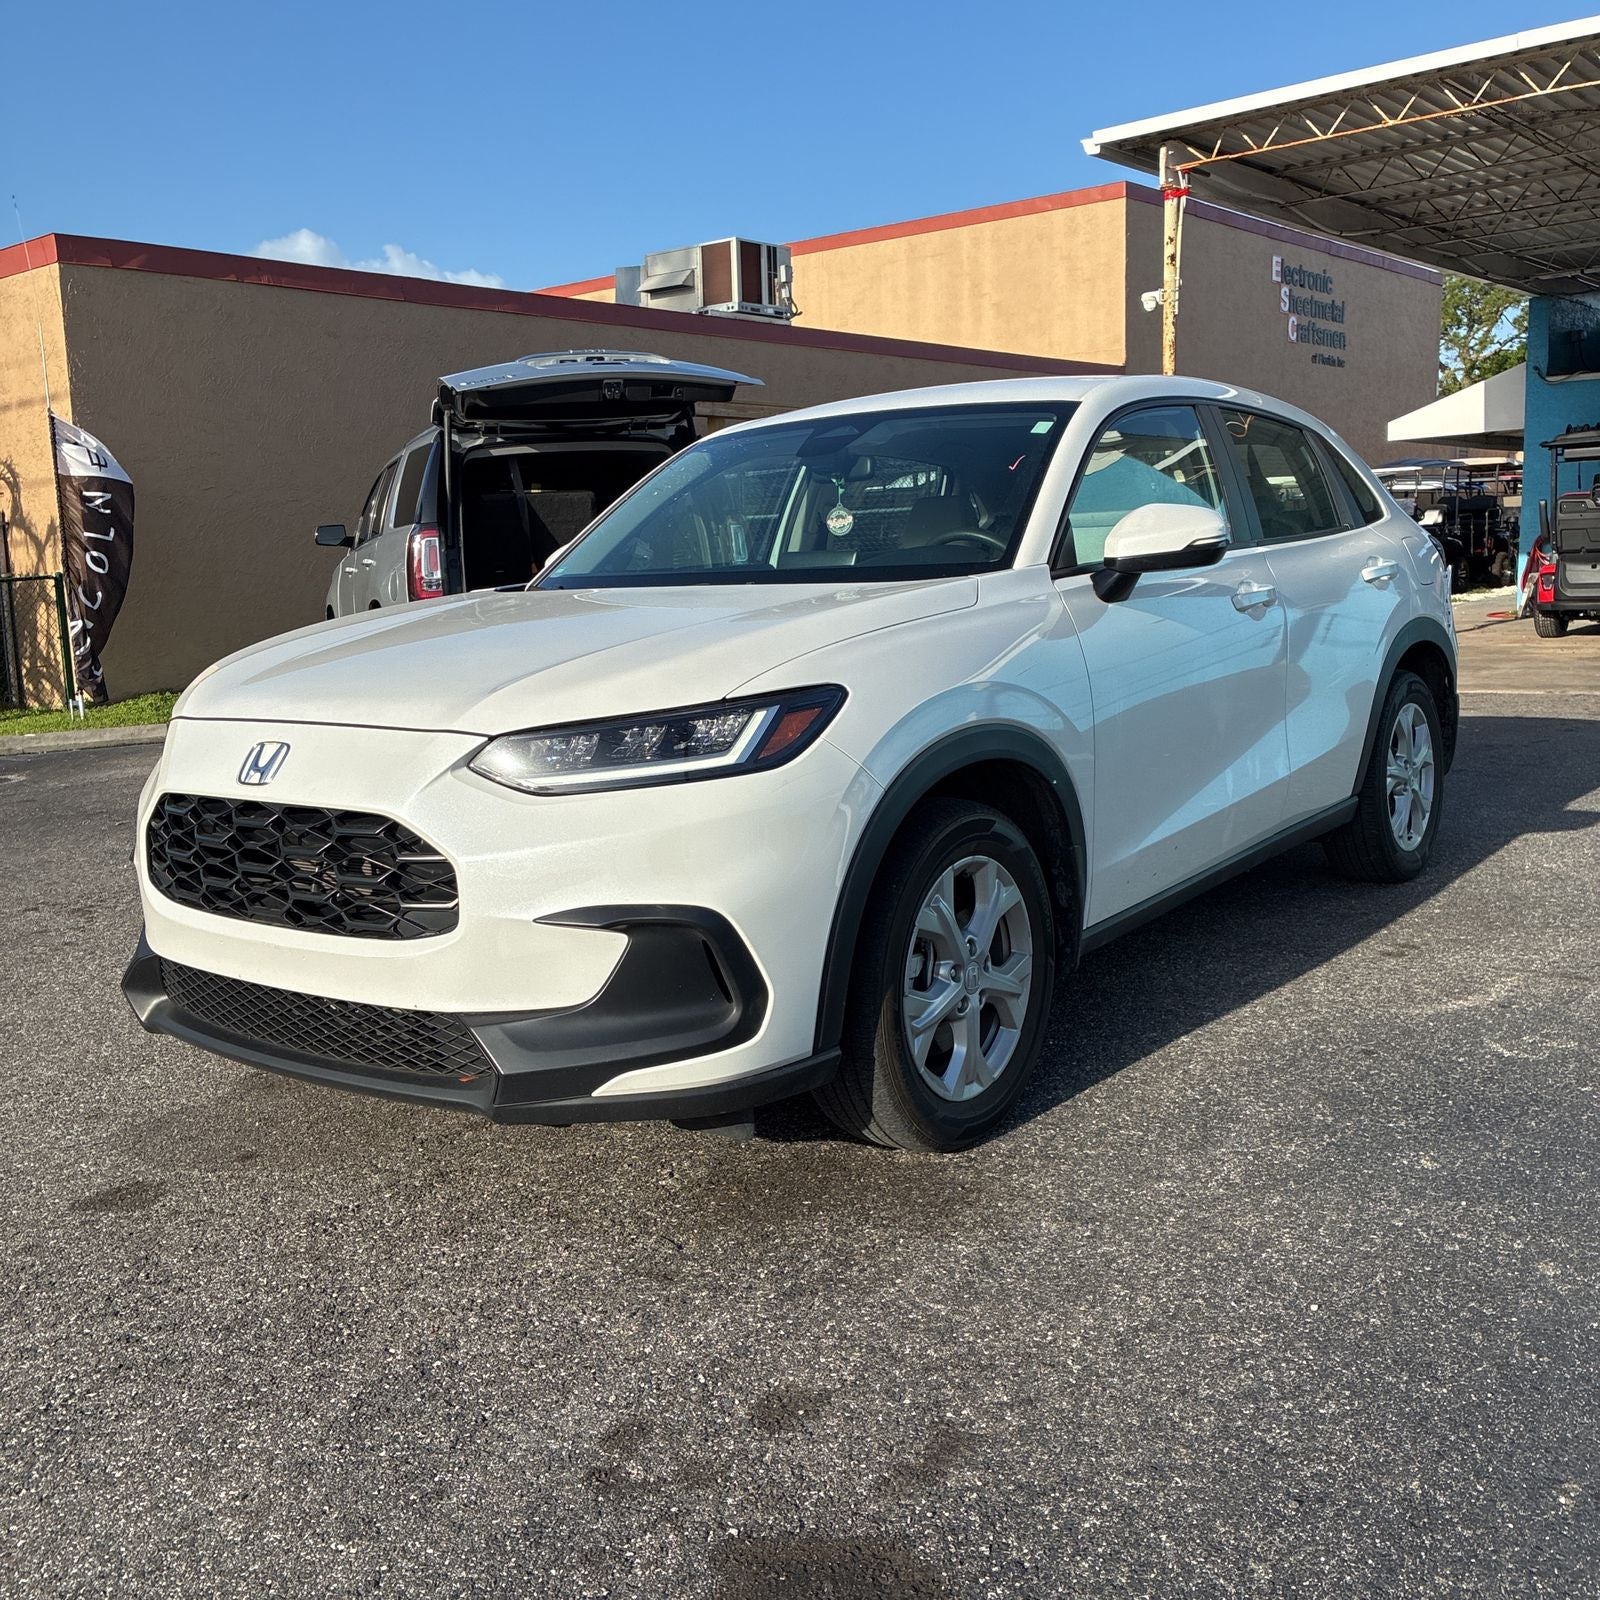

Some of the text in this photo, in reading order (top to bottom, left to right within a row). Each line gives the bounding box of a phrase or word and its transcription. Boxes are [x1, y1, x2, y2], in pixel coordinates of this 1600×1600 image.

[1272, 255, 1333, 295] Electronic
[1280, 286, 1345, 324] Sheetmetal
[1288, 315, 1346, 351] Craftsmen
[69, 490, 115, 678] NCOLN
